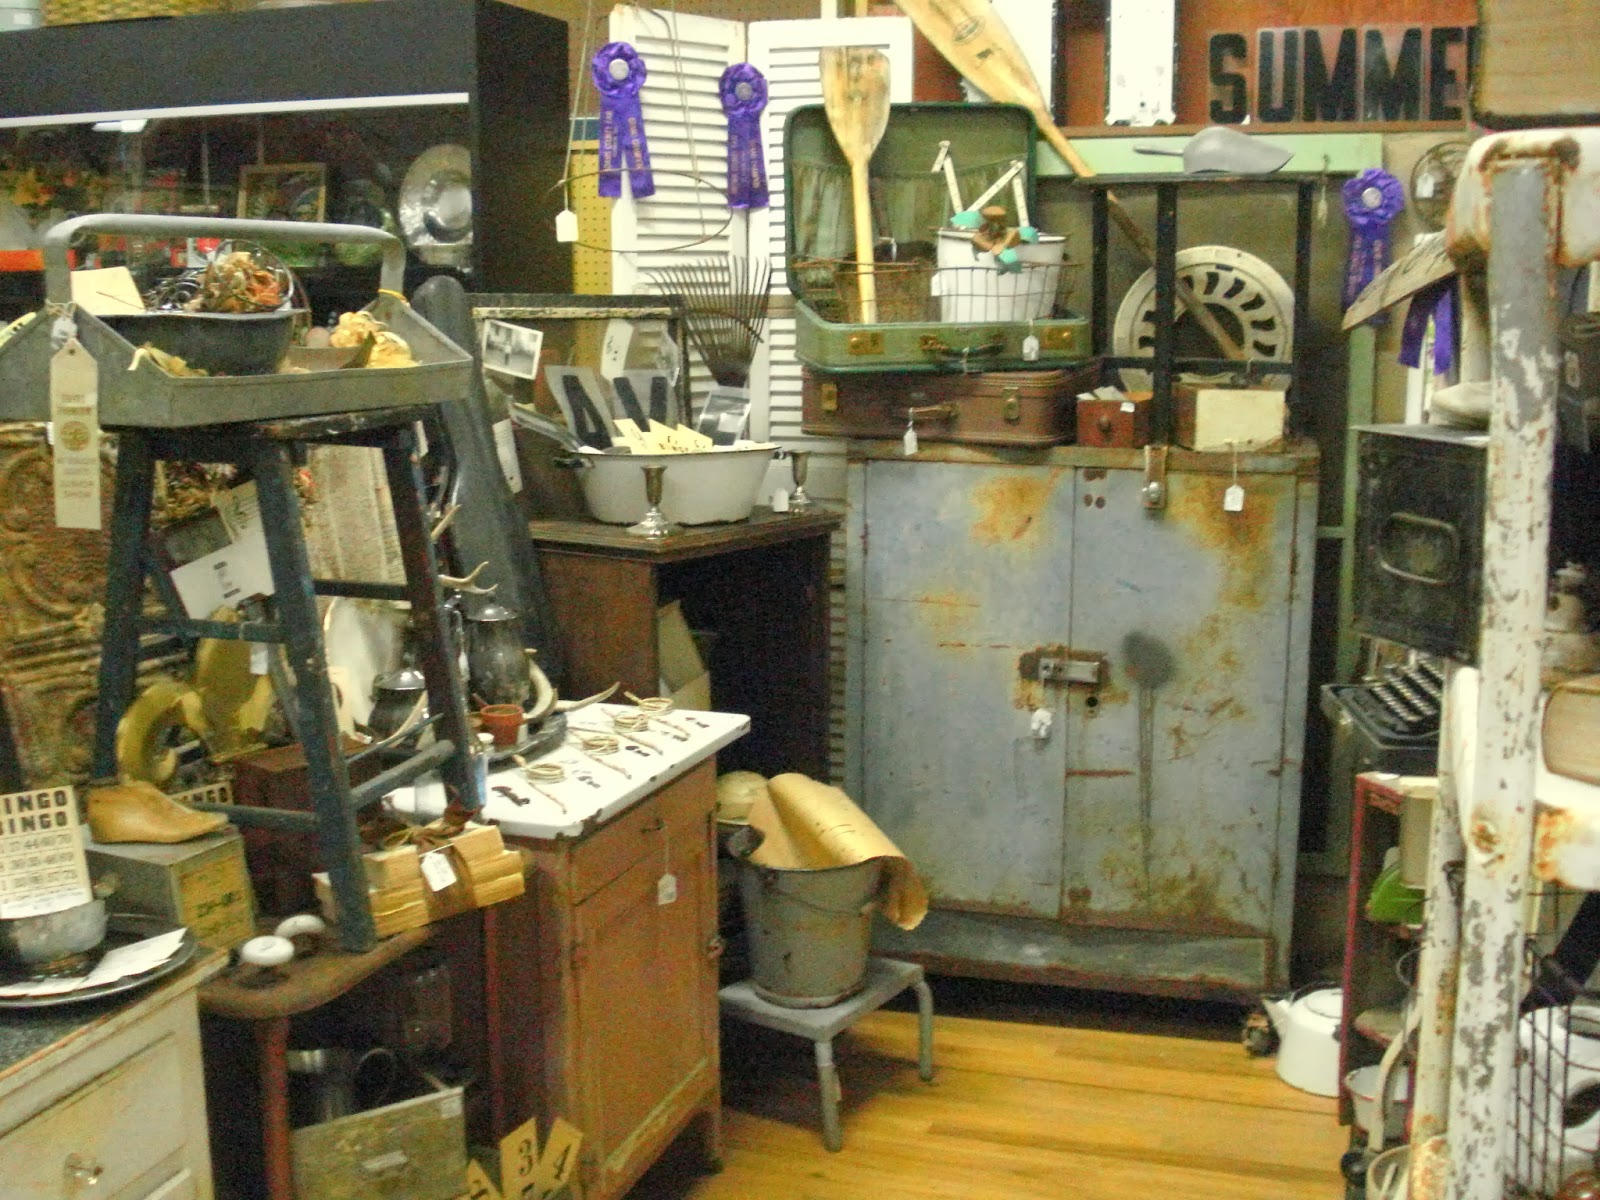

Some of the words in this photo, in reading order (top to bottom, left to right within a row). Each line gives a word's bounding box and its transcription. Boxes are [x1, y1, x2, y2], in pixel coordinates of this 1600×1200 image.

[1209, 27, 1475, 123] SUMME
[4, 790, 68, 815] INGO
[519, 1139, 534, 1176] 3
